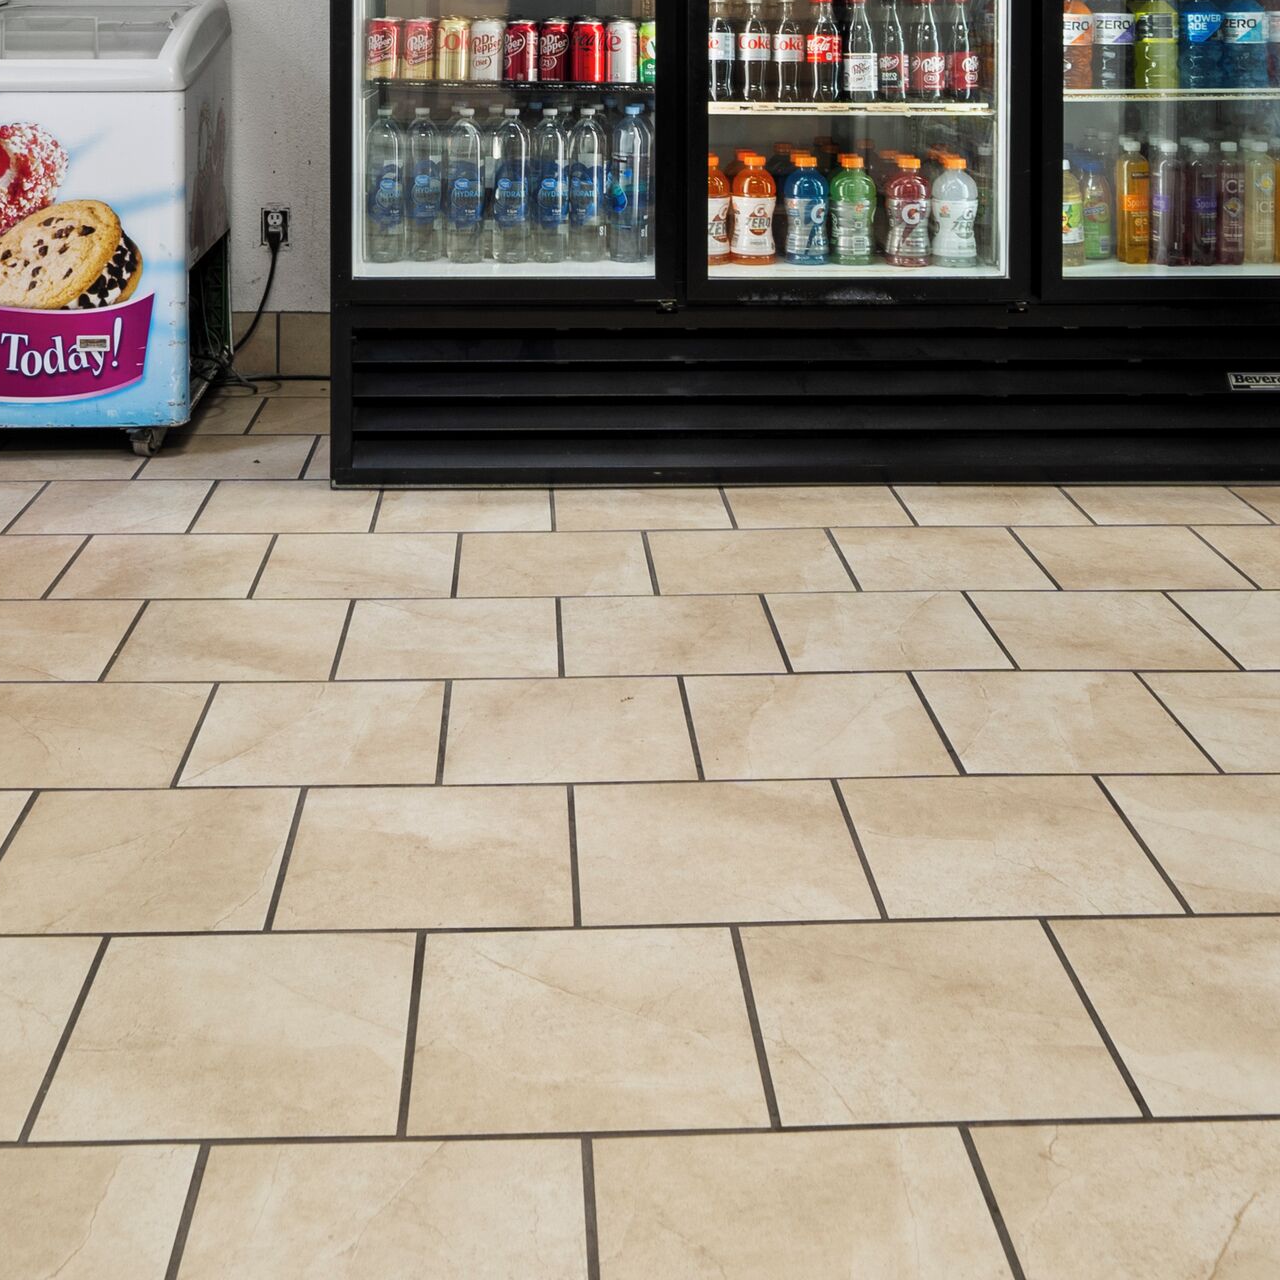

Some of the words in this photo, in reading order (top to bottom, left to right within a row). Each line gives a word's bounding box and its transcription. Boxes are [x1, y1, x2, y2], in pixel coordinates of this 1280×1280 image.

[1096, 20, 1132, 29] ZERO
[739, 36, 770, 51] Coke
[1221, 179, 1244, 193] ICE
[0, 316, 123, 377] Today!
